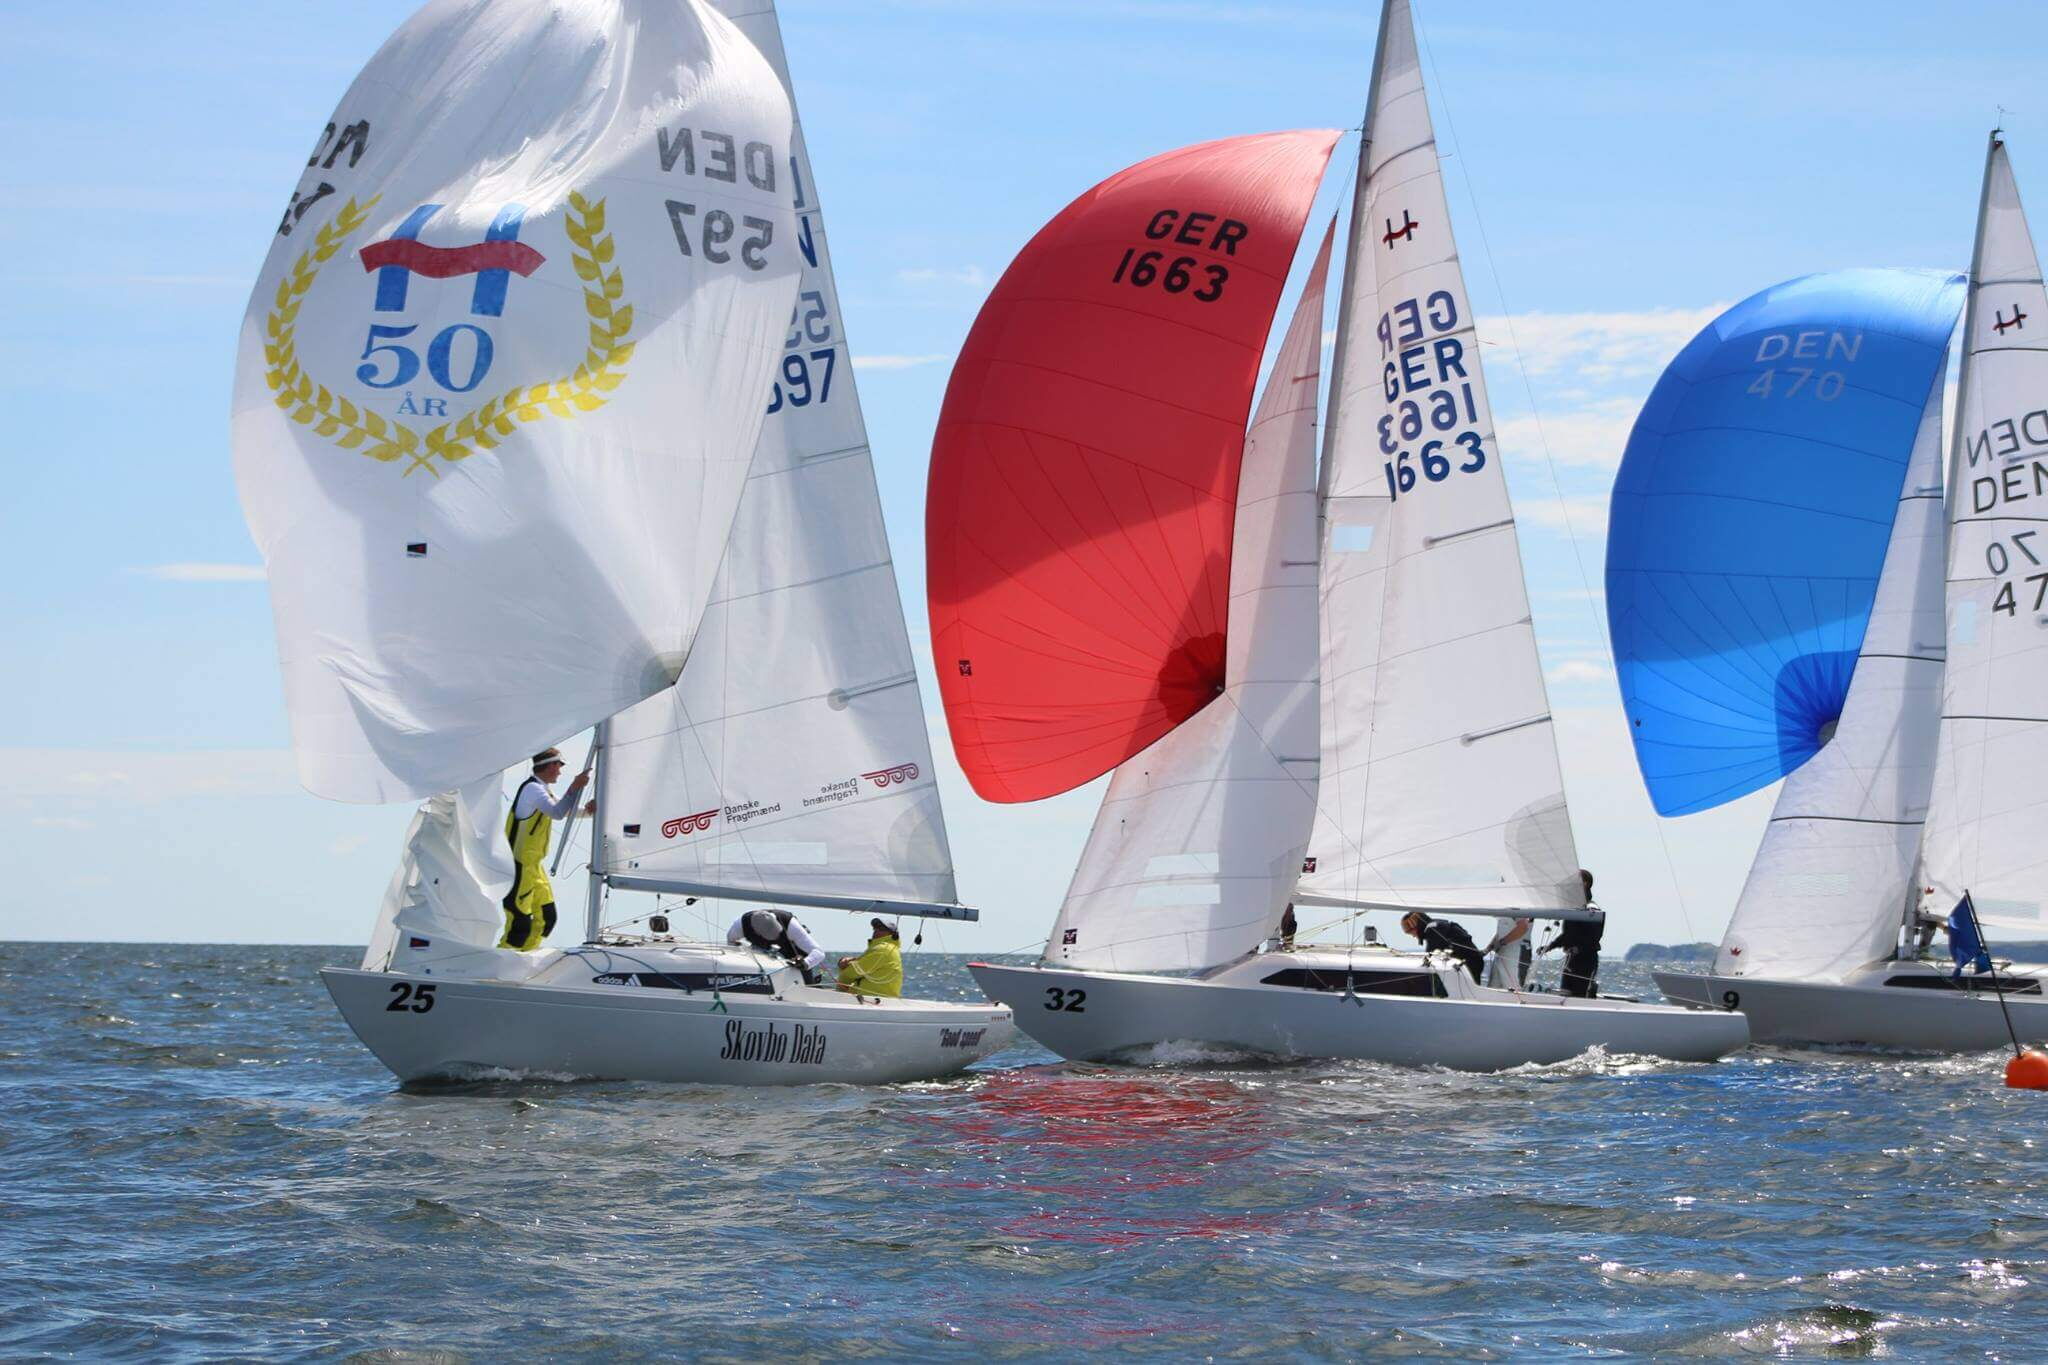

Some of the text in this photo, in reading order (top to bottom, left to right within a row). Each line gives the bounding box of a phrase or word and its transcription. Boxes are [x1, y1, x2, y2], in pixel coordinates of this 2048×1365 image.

[1145, 209, 1248, 256] GER
[1112, 248, 1229, 302] 1663
[356, 323, 494, 393] 50
[1753, 331, 1863, 362] DEN
[1384, 338, 1468, 404] GER
[1747, 367, 1846, 401] 470
[396, 391, 448, 417] ÅR
[1385, 431, 1486, 502] 1663
[724, 800, 760, 815] Danske
[726, 803, 781, 824] Fragtmænd
[386, 982, 437, 1014] 25
[1044, 987, 1087, 1013] 32
[1723, 991, 1740, 1011] 9
[720, 1019, 827, 1065] Skovbo Data
